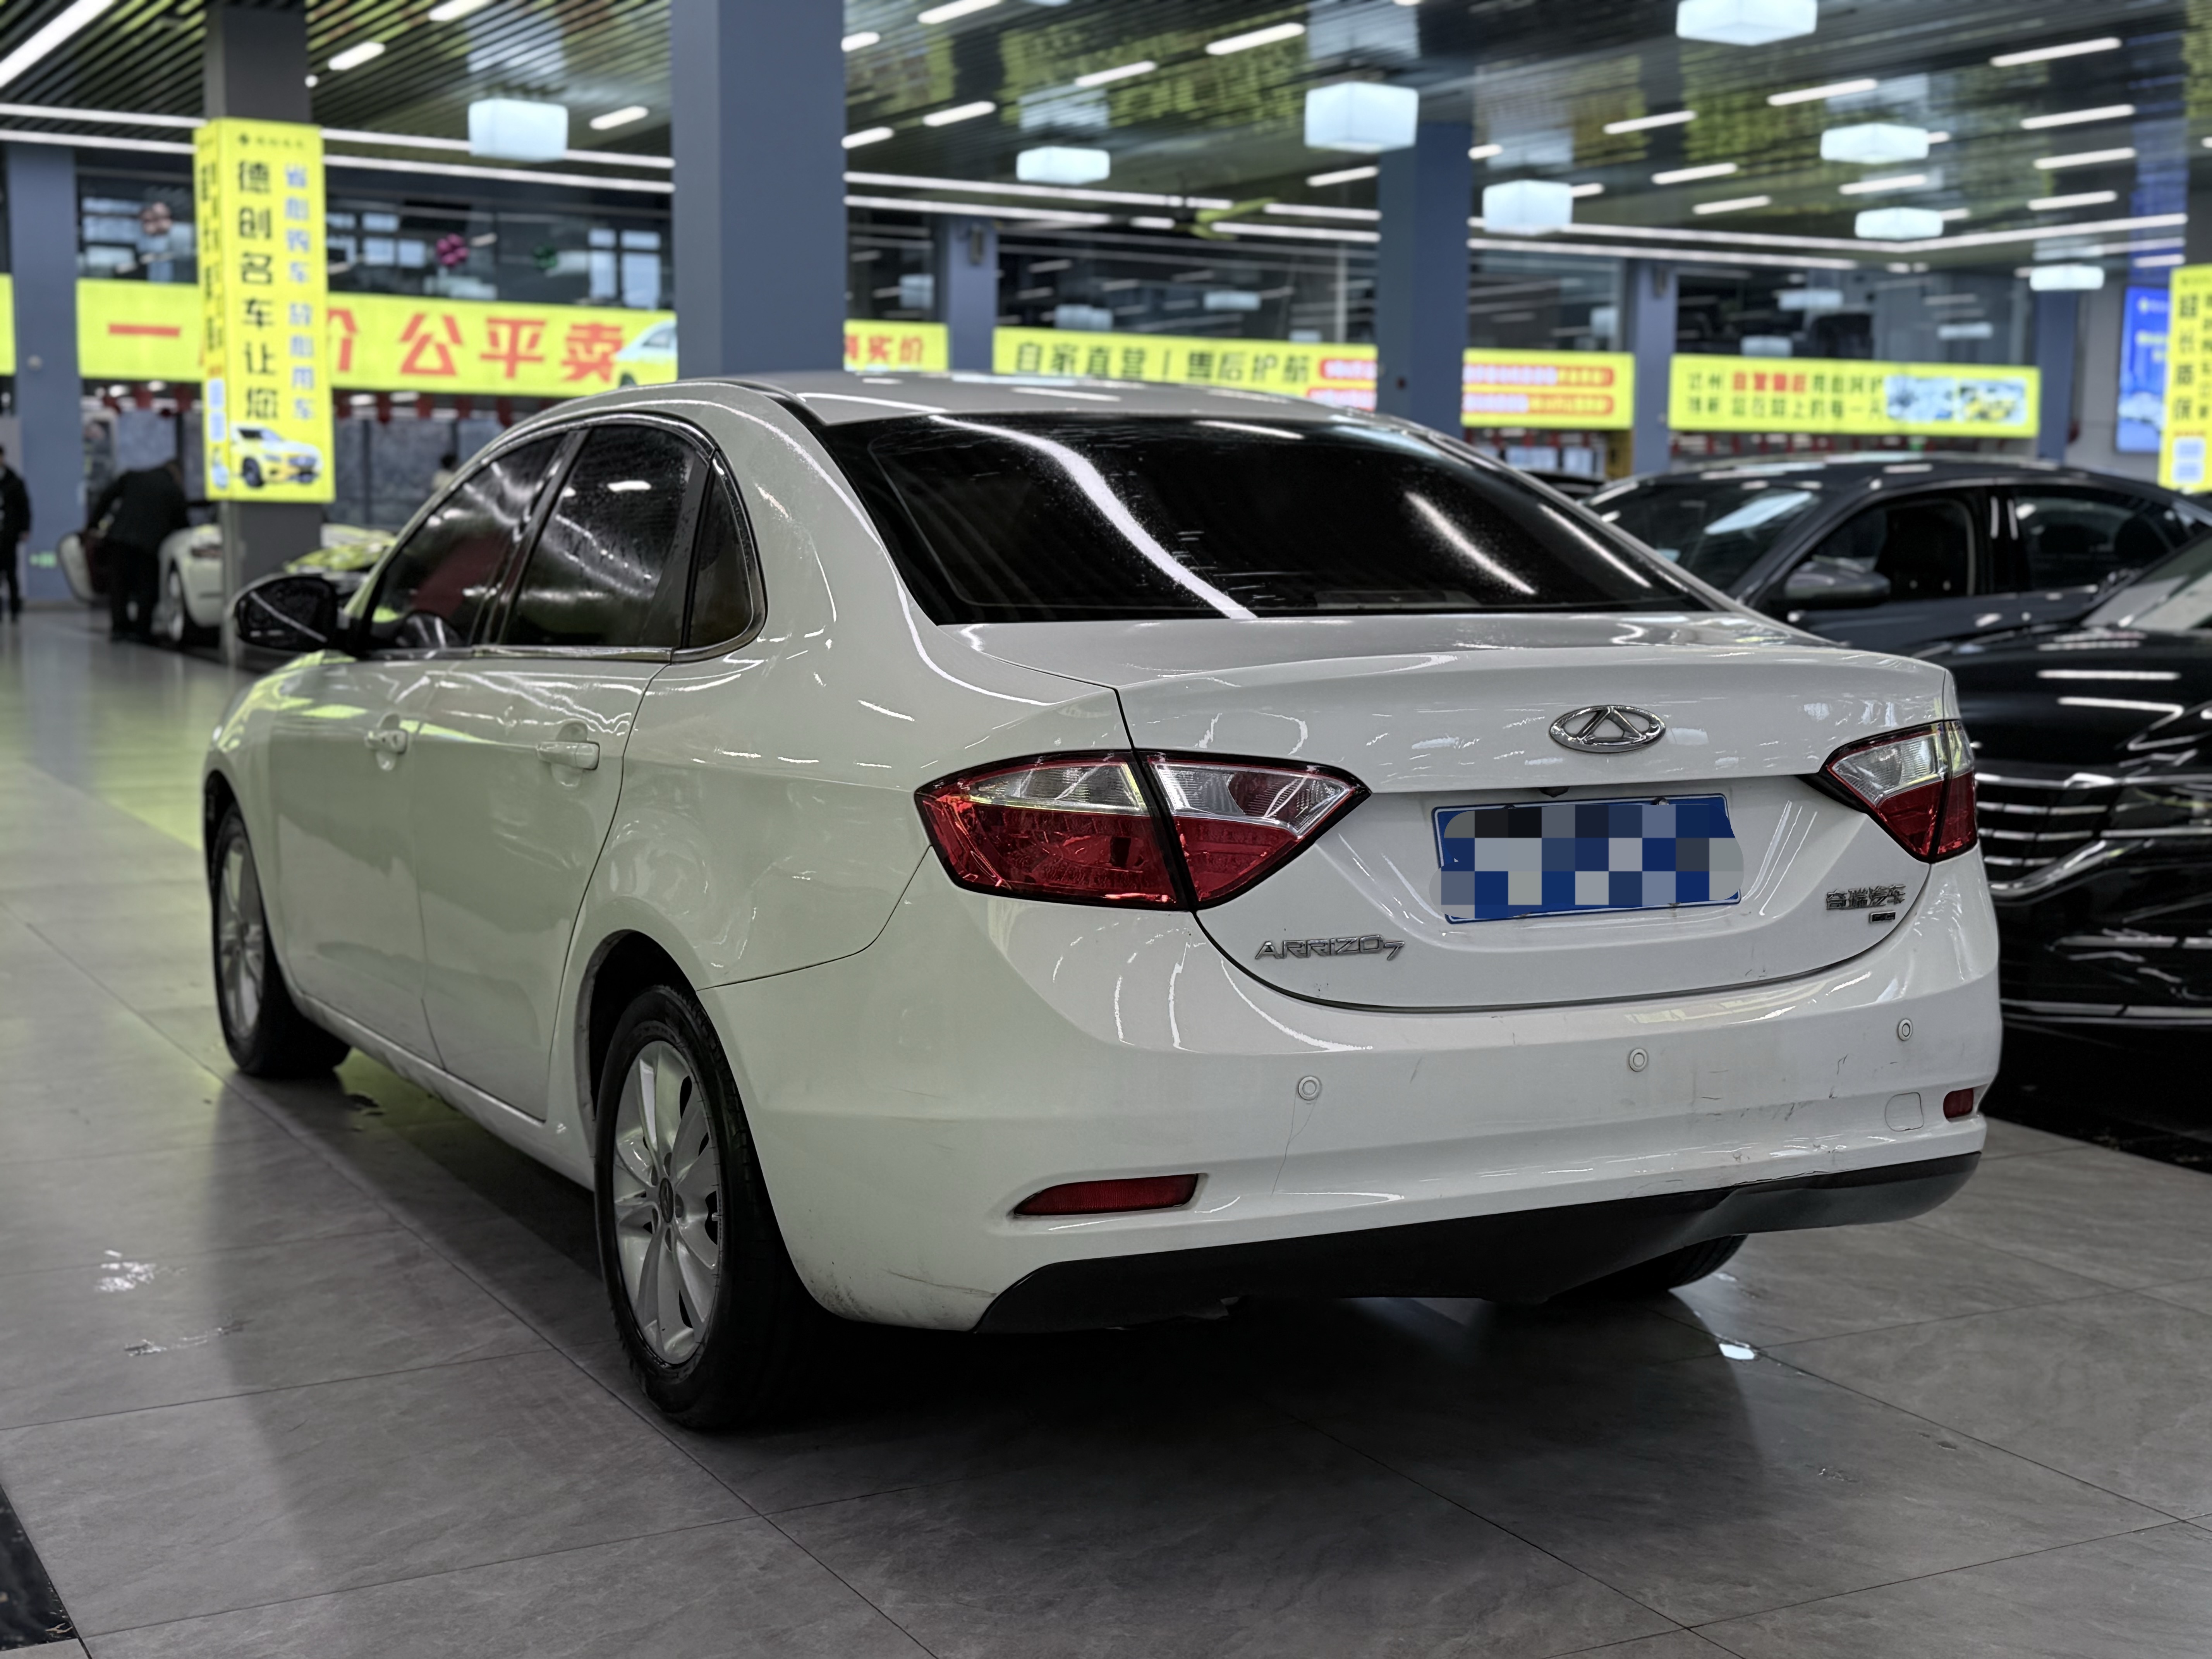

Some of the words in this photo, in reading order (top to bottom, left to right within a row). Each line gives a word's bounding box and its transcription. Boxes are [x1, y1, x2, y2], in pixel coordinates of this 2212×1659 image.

[238, 160, 278, 420] 德创名车让您
